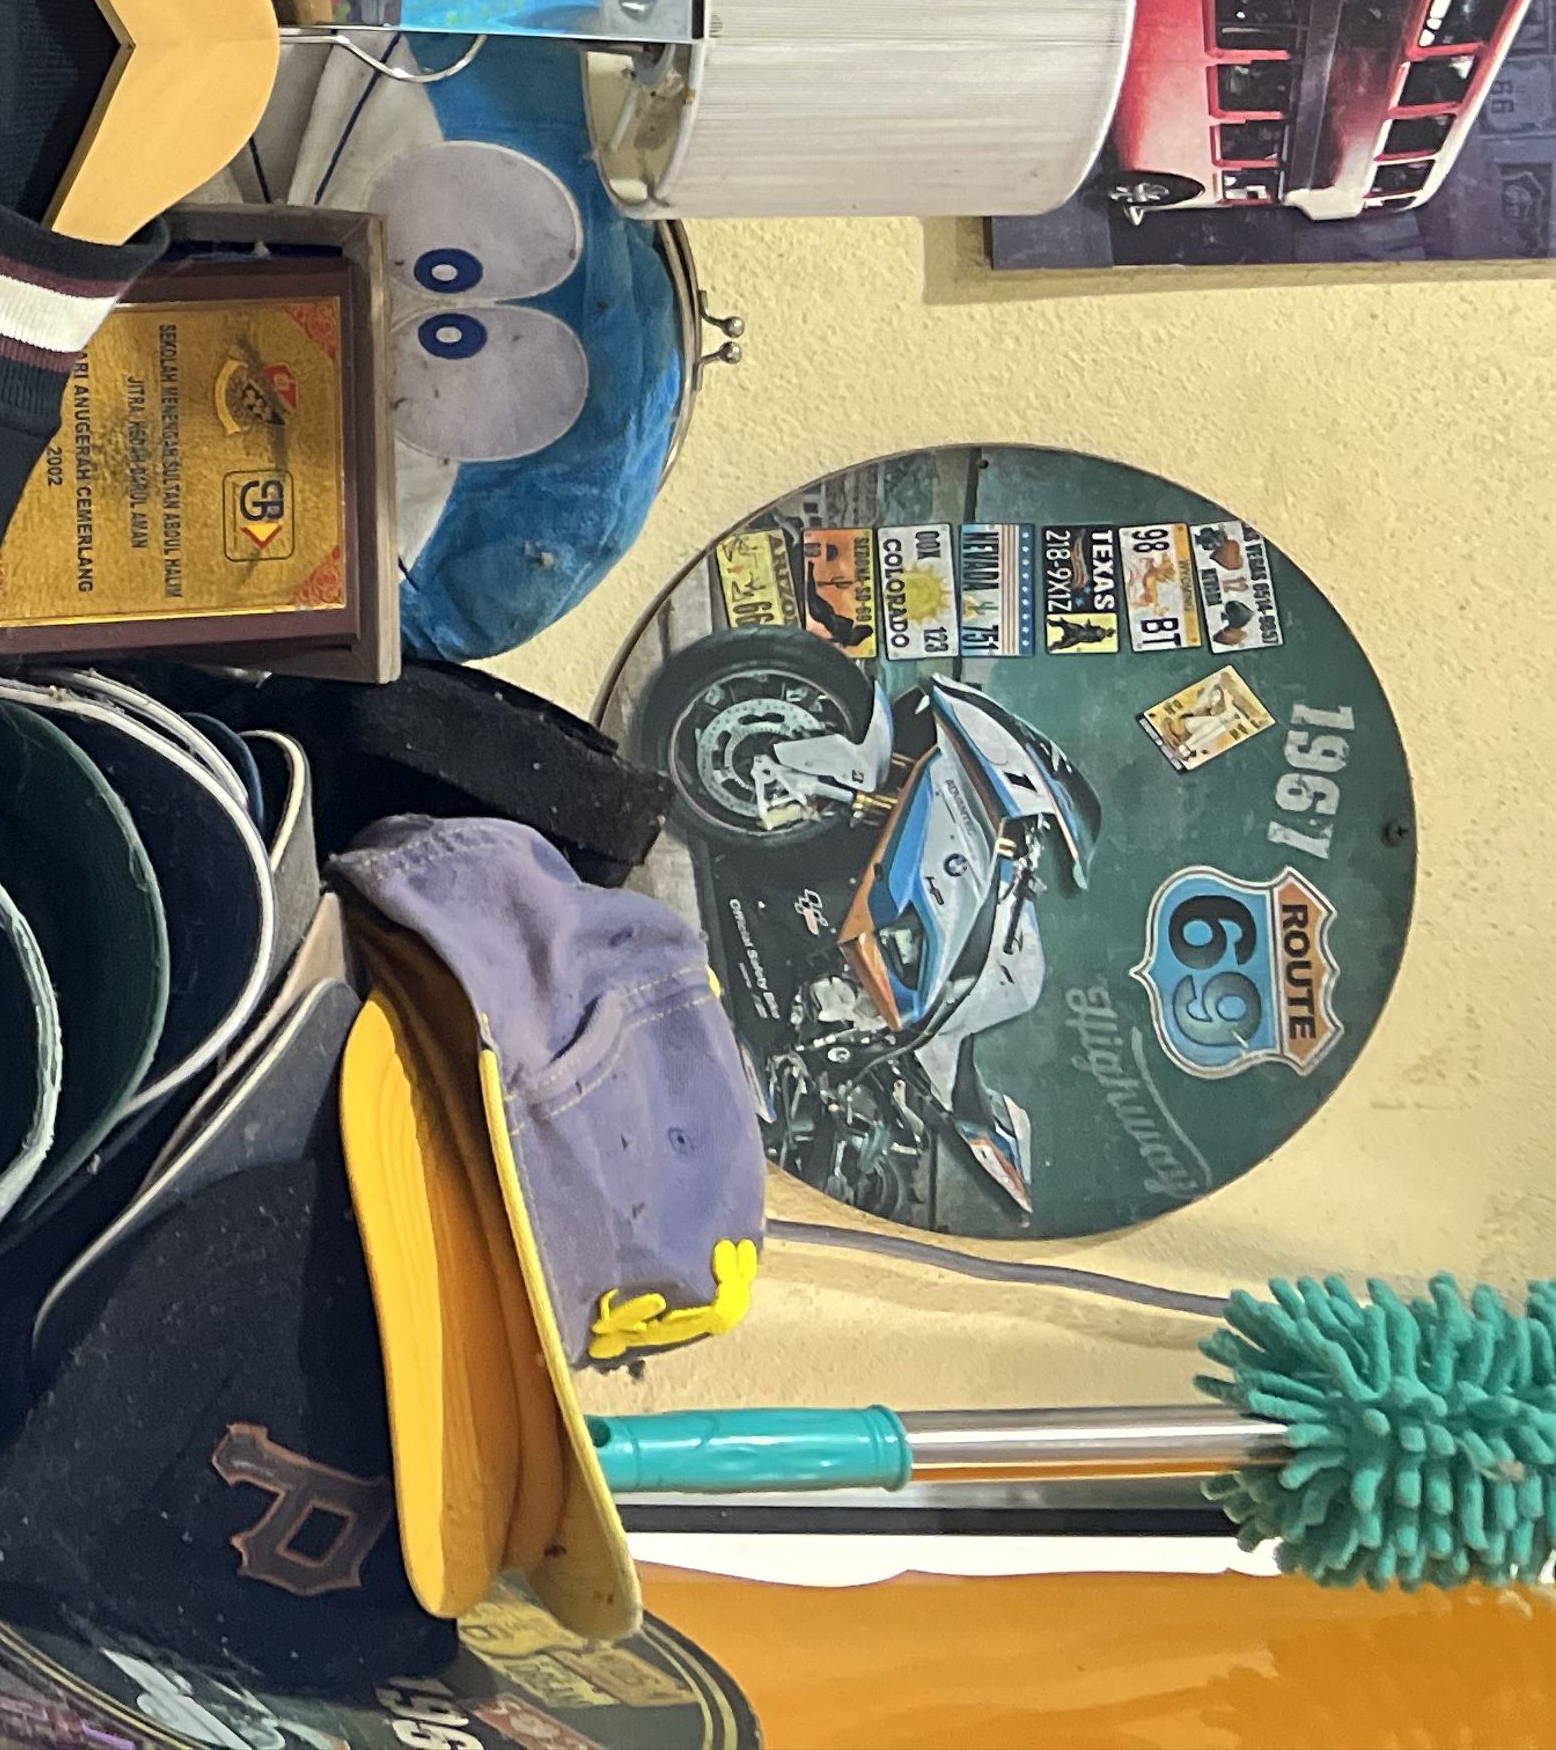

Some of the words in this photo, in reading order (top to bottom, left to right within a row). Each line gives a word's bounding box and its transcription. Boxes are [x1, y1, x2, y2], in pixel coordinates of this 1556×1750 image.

[158, 324, 179, 383] SEKOLAH
[73, 384, 92, 481] ANUGERAH
[160, 386, 181, 457] MENENGAH
[45, 445, 63, 487] 2002
[161, 460, 181, 509] SULTAN
[75, 486, 94, 593] CEMERLANG
[131, 511, 152, 549] AMAN
[163, 513, 182, 556] ABDUL
[1131, 528, 1171, 554] 98
[164, 558, 184, 599] HALIM
[962, 530, 1000, 592] NEVADA
[1044, 529, 1073, 613] 218-9X1Z
[1091, 529, 1116, 611] TEXAS
[1178, 559, 1194, 612] WYOMING
[882, 537, 911, 649] COLORADO
[923, 626, 949, 654] 123
[962, 624, 1000, 651] 751
[1139, 616, 1182, 648] BT
[1003, 771, 1038, 793] 1
[1266, 703, 1356, 860] 1967
[728, 898, 754, 948] Official
[745, 949, 768, 991] Safety
[1166, 894, 1263, 1048] 69
[1281, 903, 1317, 1041] ROUTE
[1064, 985, 1211, 1198] Highway
